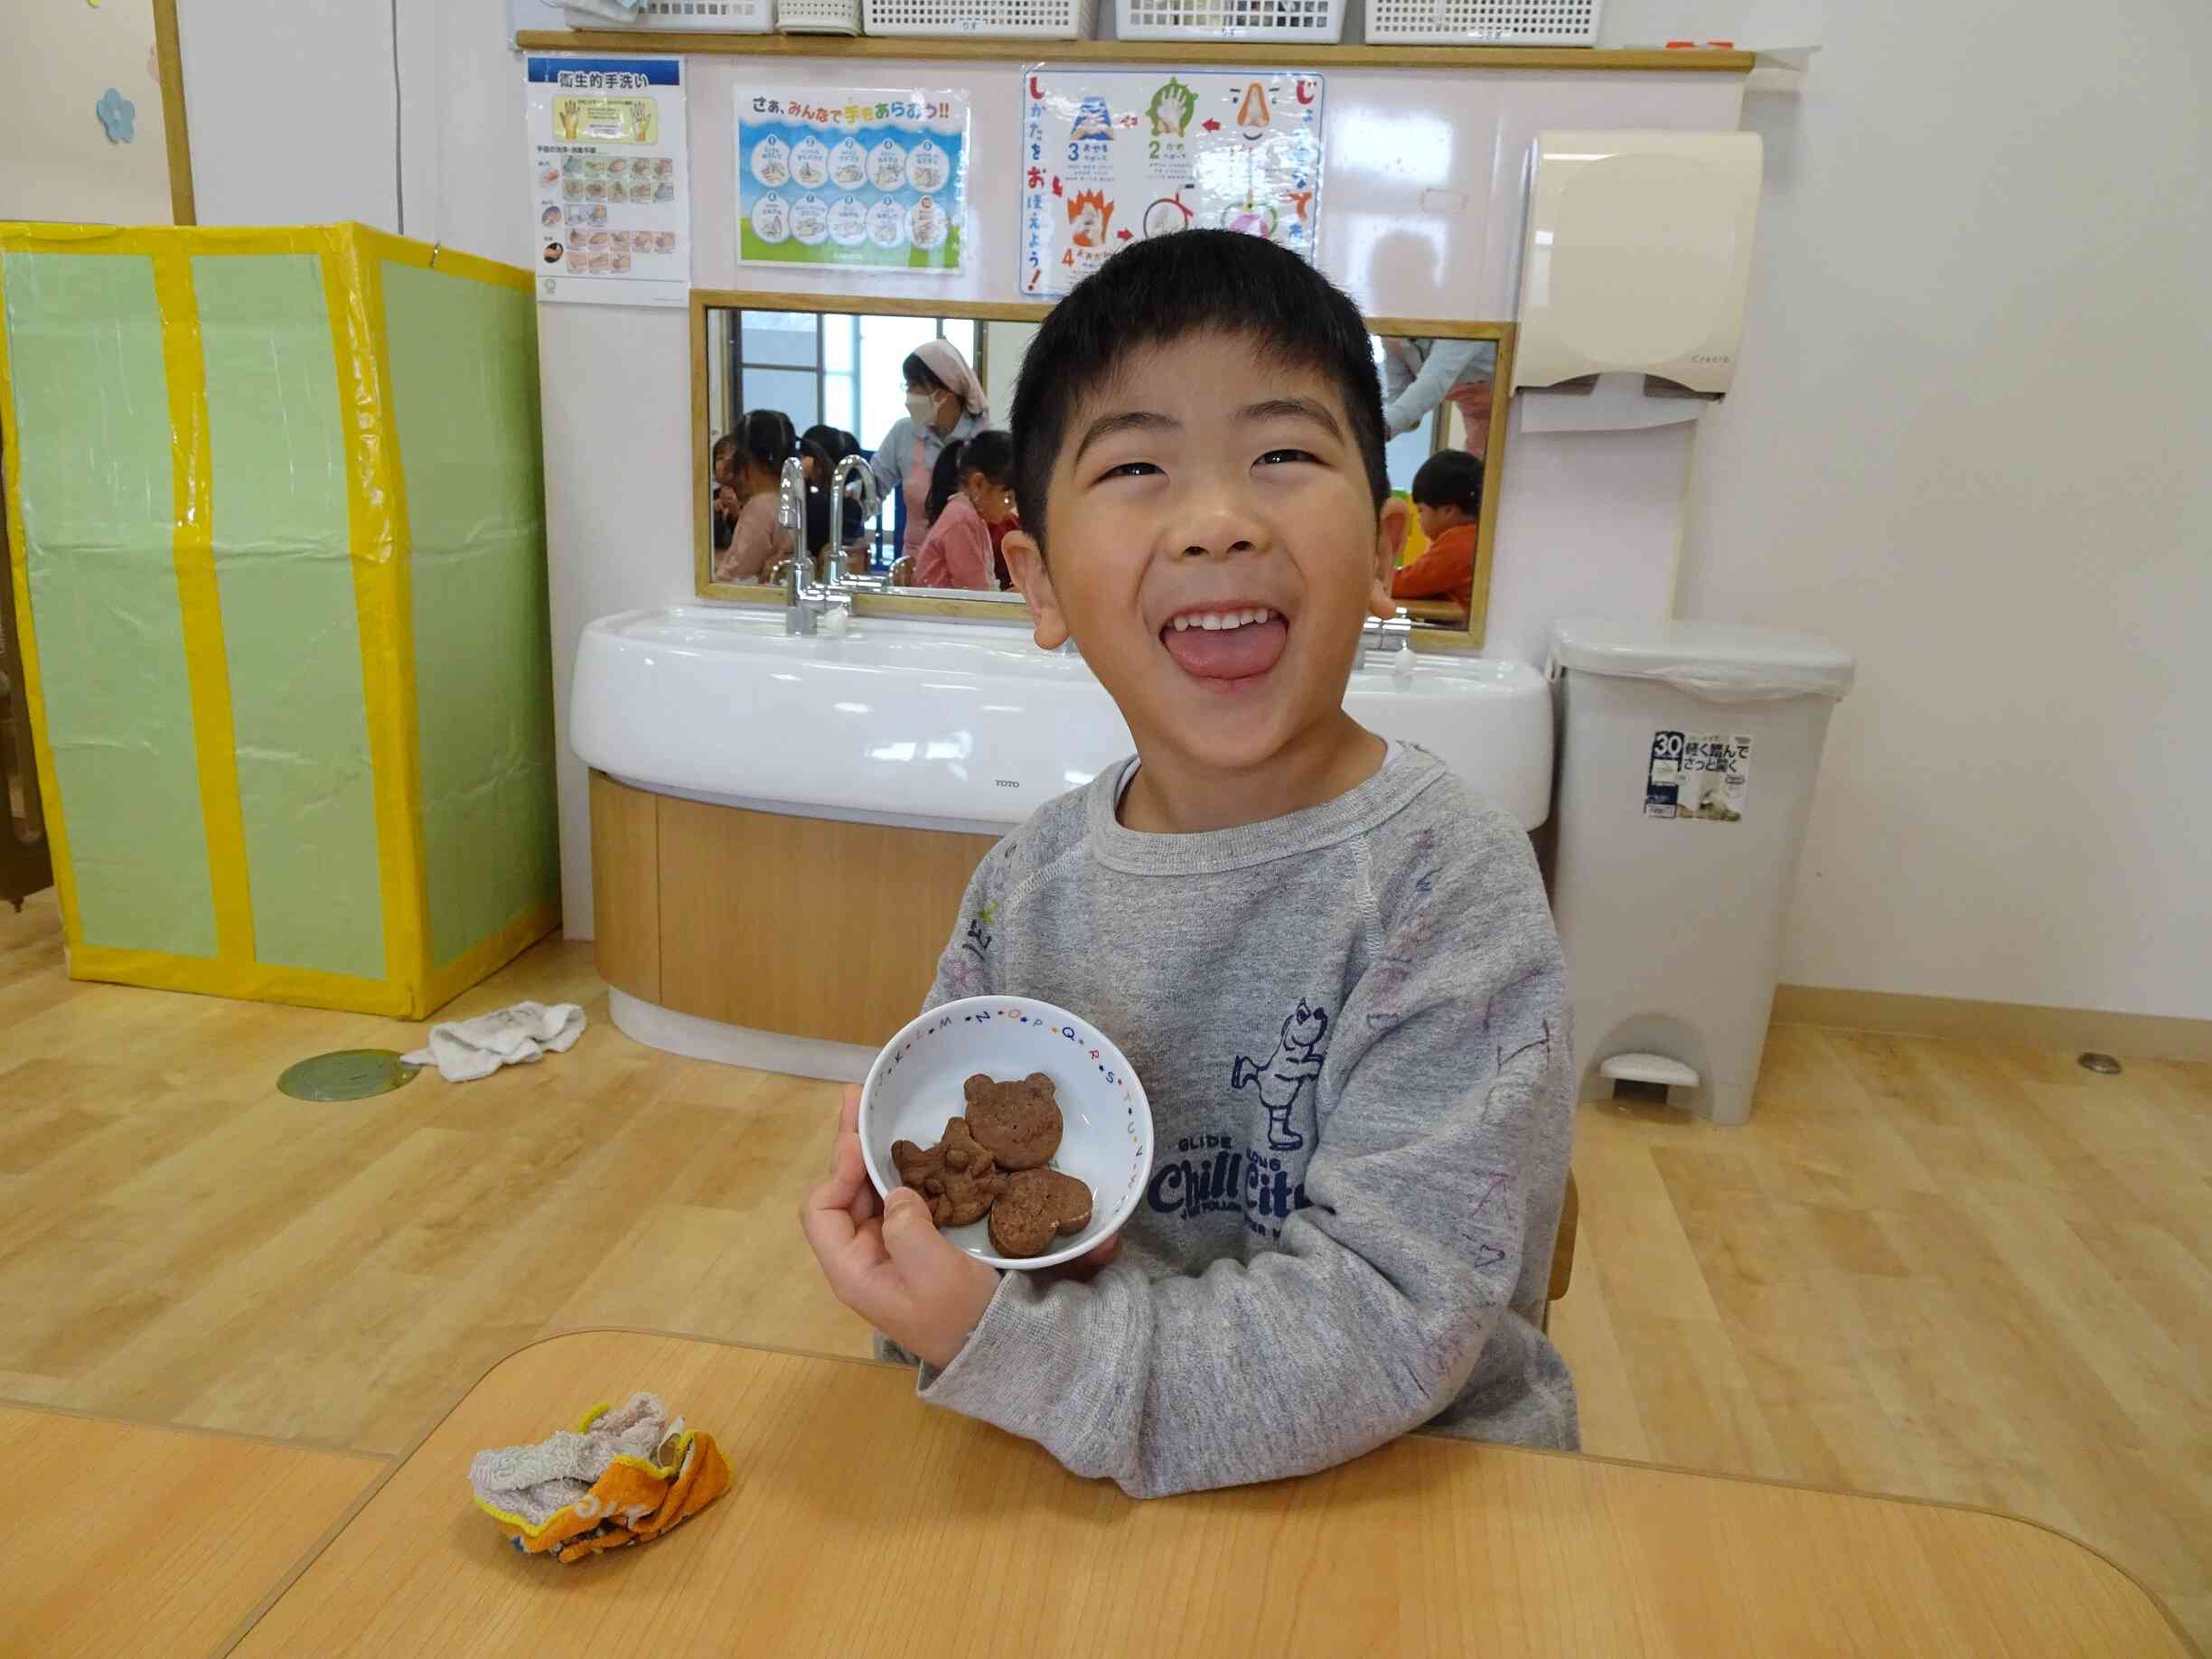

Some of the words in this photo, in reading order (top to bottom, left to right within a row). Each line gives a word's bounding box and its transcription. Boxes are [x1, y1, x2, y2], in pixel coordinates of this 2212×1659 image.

[558, 71, 649, 89] 衛生的手洗い
[1068, 142, 1079, 161] 3
[1148, 141, 1160, 159] 2
[1062, 248, 1073, 267] 4
[1654, 735, 1682, 755] 30
[1685, 742, 1750, 759] 軽く踏んで
[996, 780, 1020, 788] TOTO
[1178, 1134, 1232, 1152] GLIDE
[1148, 1150, 1242, 1214] Chill
[1201, 1200, 1243, 1213] FOLLO
